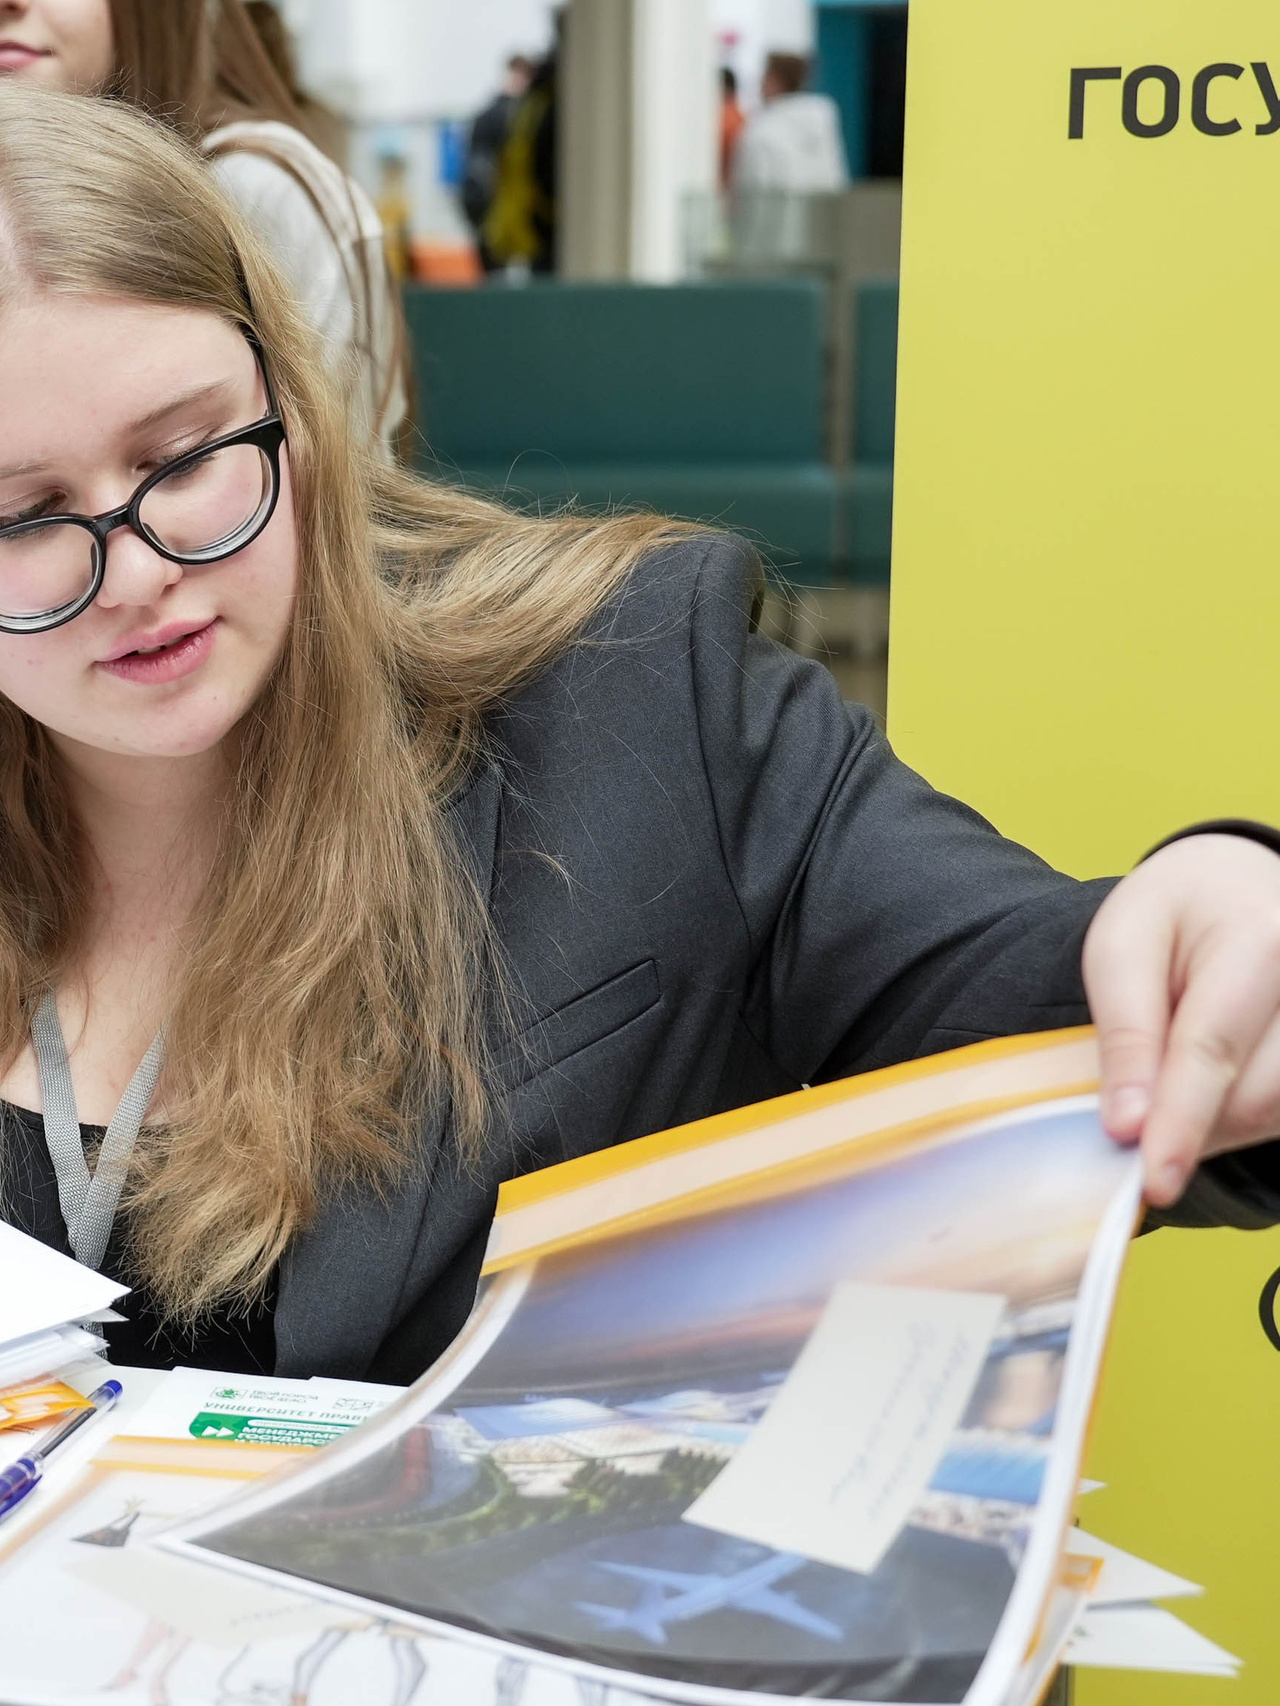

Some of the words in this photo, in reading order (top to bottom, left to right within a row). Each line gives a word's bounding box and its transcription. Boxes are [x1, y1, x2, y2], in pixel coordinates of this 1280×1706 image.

[203, 1402, 320, 1420] УНИВЕРСИТЕТ
[236, 1433, 331, 1445] ГОСУДАРС
[242, 1426, 344, 1439] МЕНЕДЖМЕ
